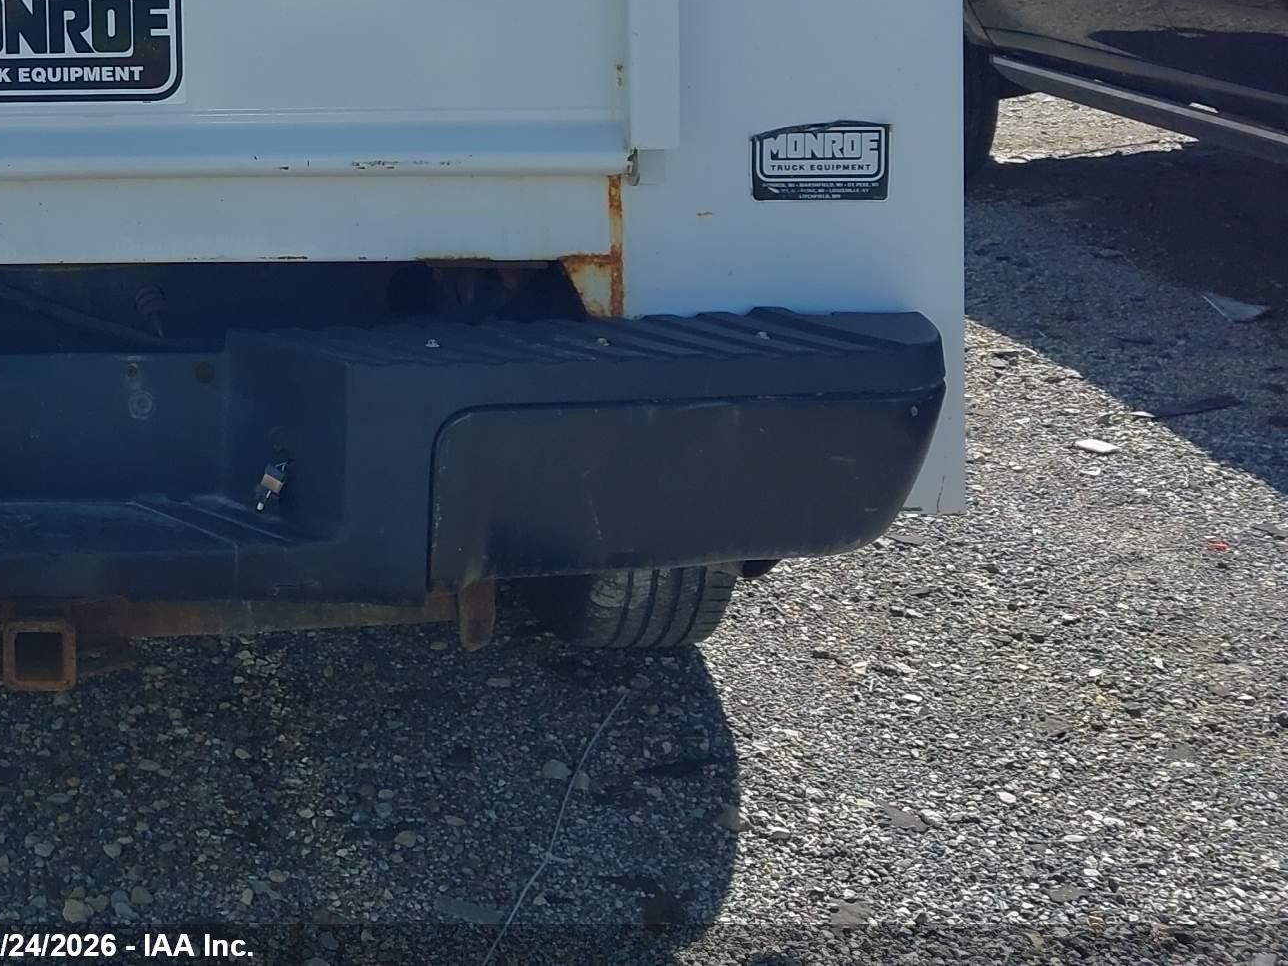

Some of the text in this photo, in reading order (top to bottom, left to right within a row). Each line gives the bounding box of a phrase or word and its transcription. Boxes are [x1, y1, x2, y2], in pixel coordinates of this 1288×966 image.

[18, 65, 144, 84] EQUIPMENT
[763, 132, 879, 159] MONROE
[770, 163, 872, 171] TRUCK EQUIPMENT
